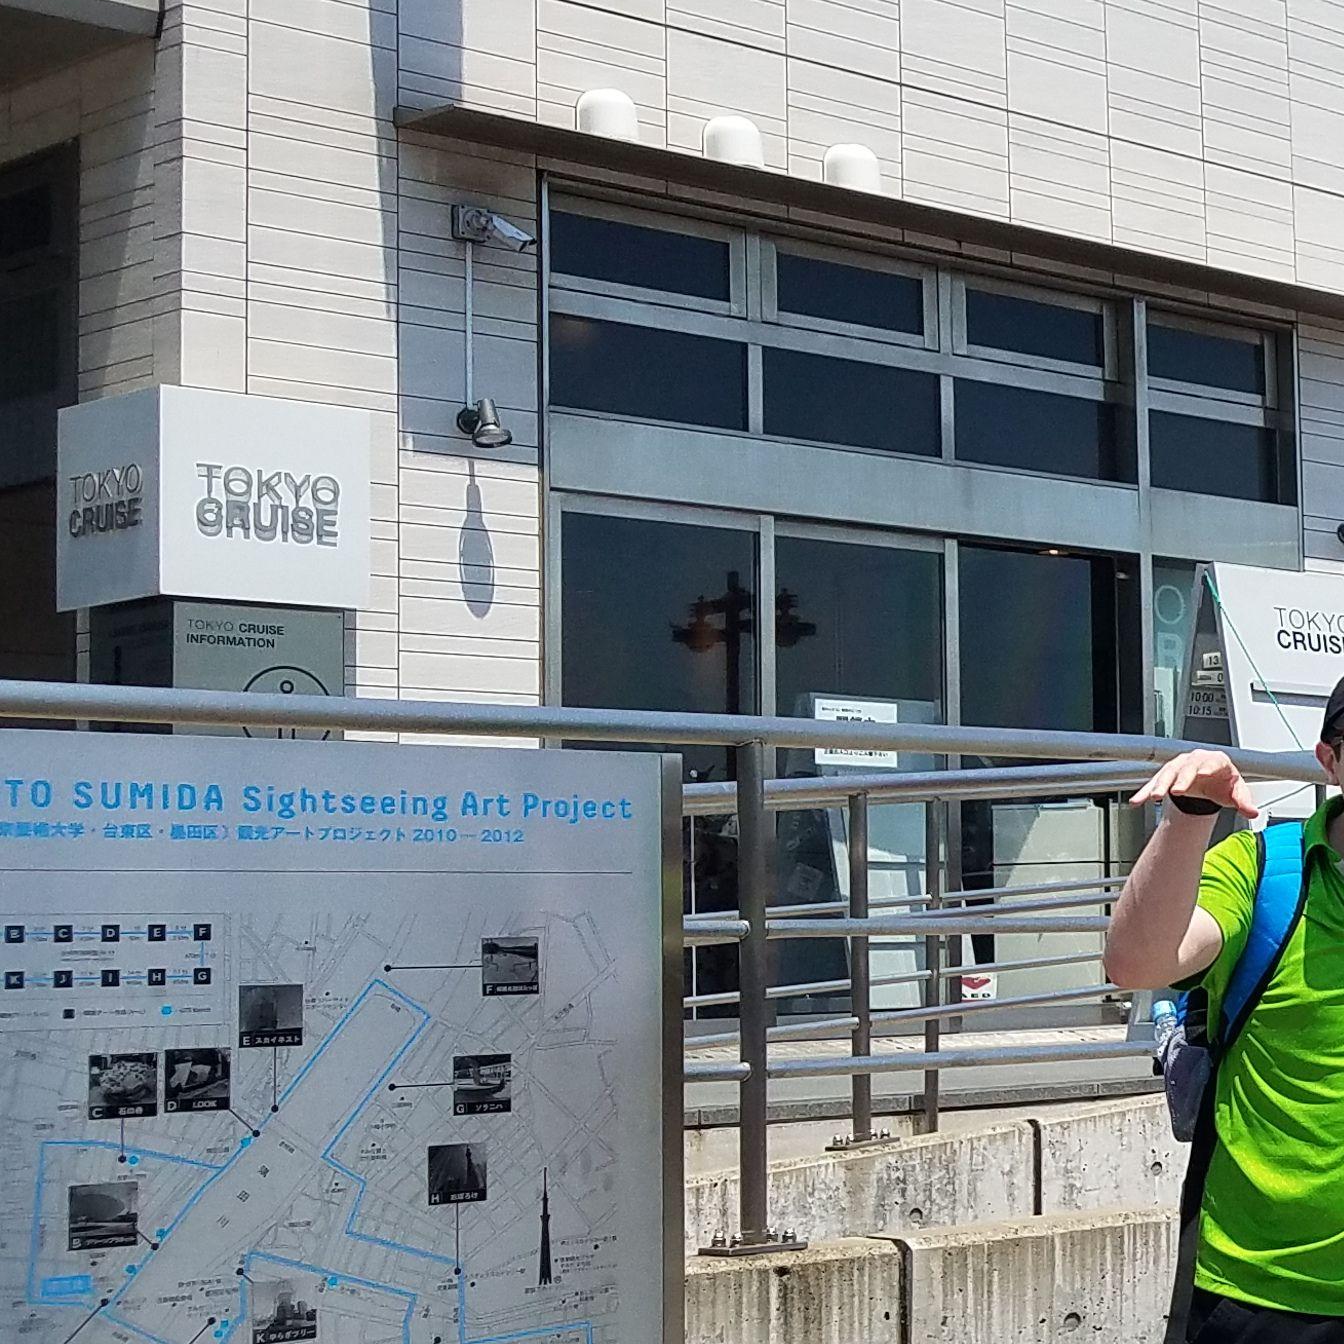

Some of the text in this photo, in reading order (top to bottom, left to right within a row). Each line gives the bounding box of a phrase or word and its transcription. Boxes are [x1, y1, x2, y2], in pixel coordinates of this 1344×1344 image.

[70, 463, 143, 504] TOKYO
[196, 463, 341, 506] TOKYO
[69, 497, 143, 538] CRUISE
[196, 497, 339, 547] CRUISE
[187, 618, 285, 636] TOKYO CRUISE
[186, 633, 275, 648] INFORMATION
[4, 779, 633, 824] TO SUMIDA Sightseeing Art Project
[412, 828, 457, 842] 2010
[480, 829, 524, 843] 2012
[58, 928, 68, 938] C
[106, 928, 116, 938] D
[153, 927, 162, 937] E
[198, 927, 207, 937] F
[153, 972, 162, 982] H
[198, 972, 207, 981] G
[486, 985, 493, 994] F
[243, 1036, 251, 1045] E
[167, 1102, 177, 1111] D
[456, 1104, 465, 1113] G
[92, 1108, 103, 1117] C
[431, 1193, 440, 1203] H
[256, 1333, 266, 1343] K
